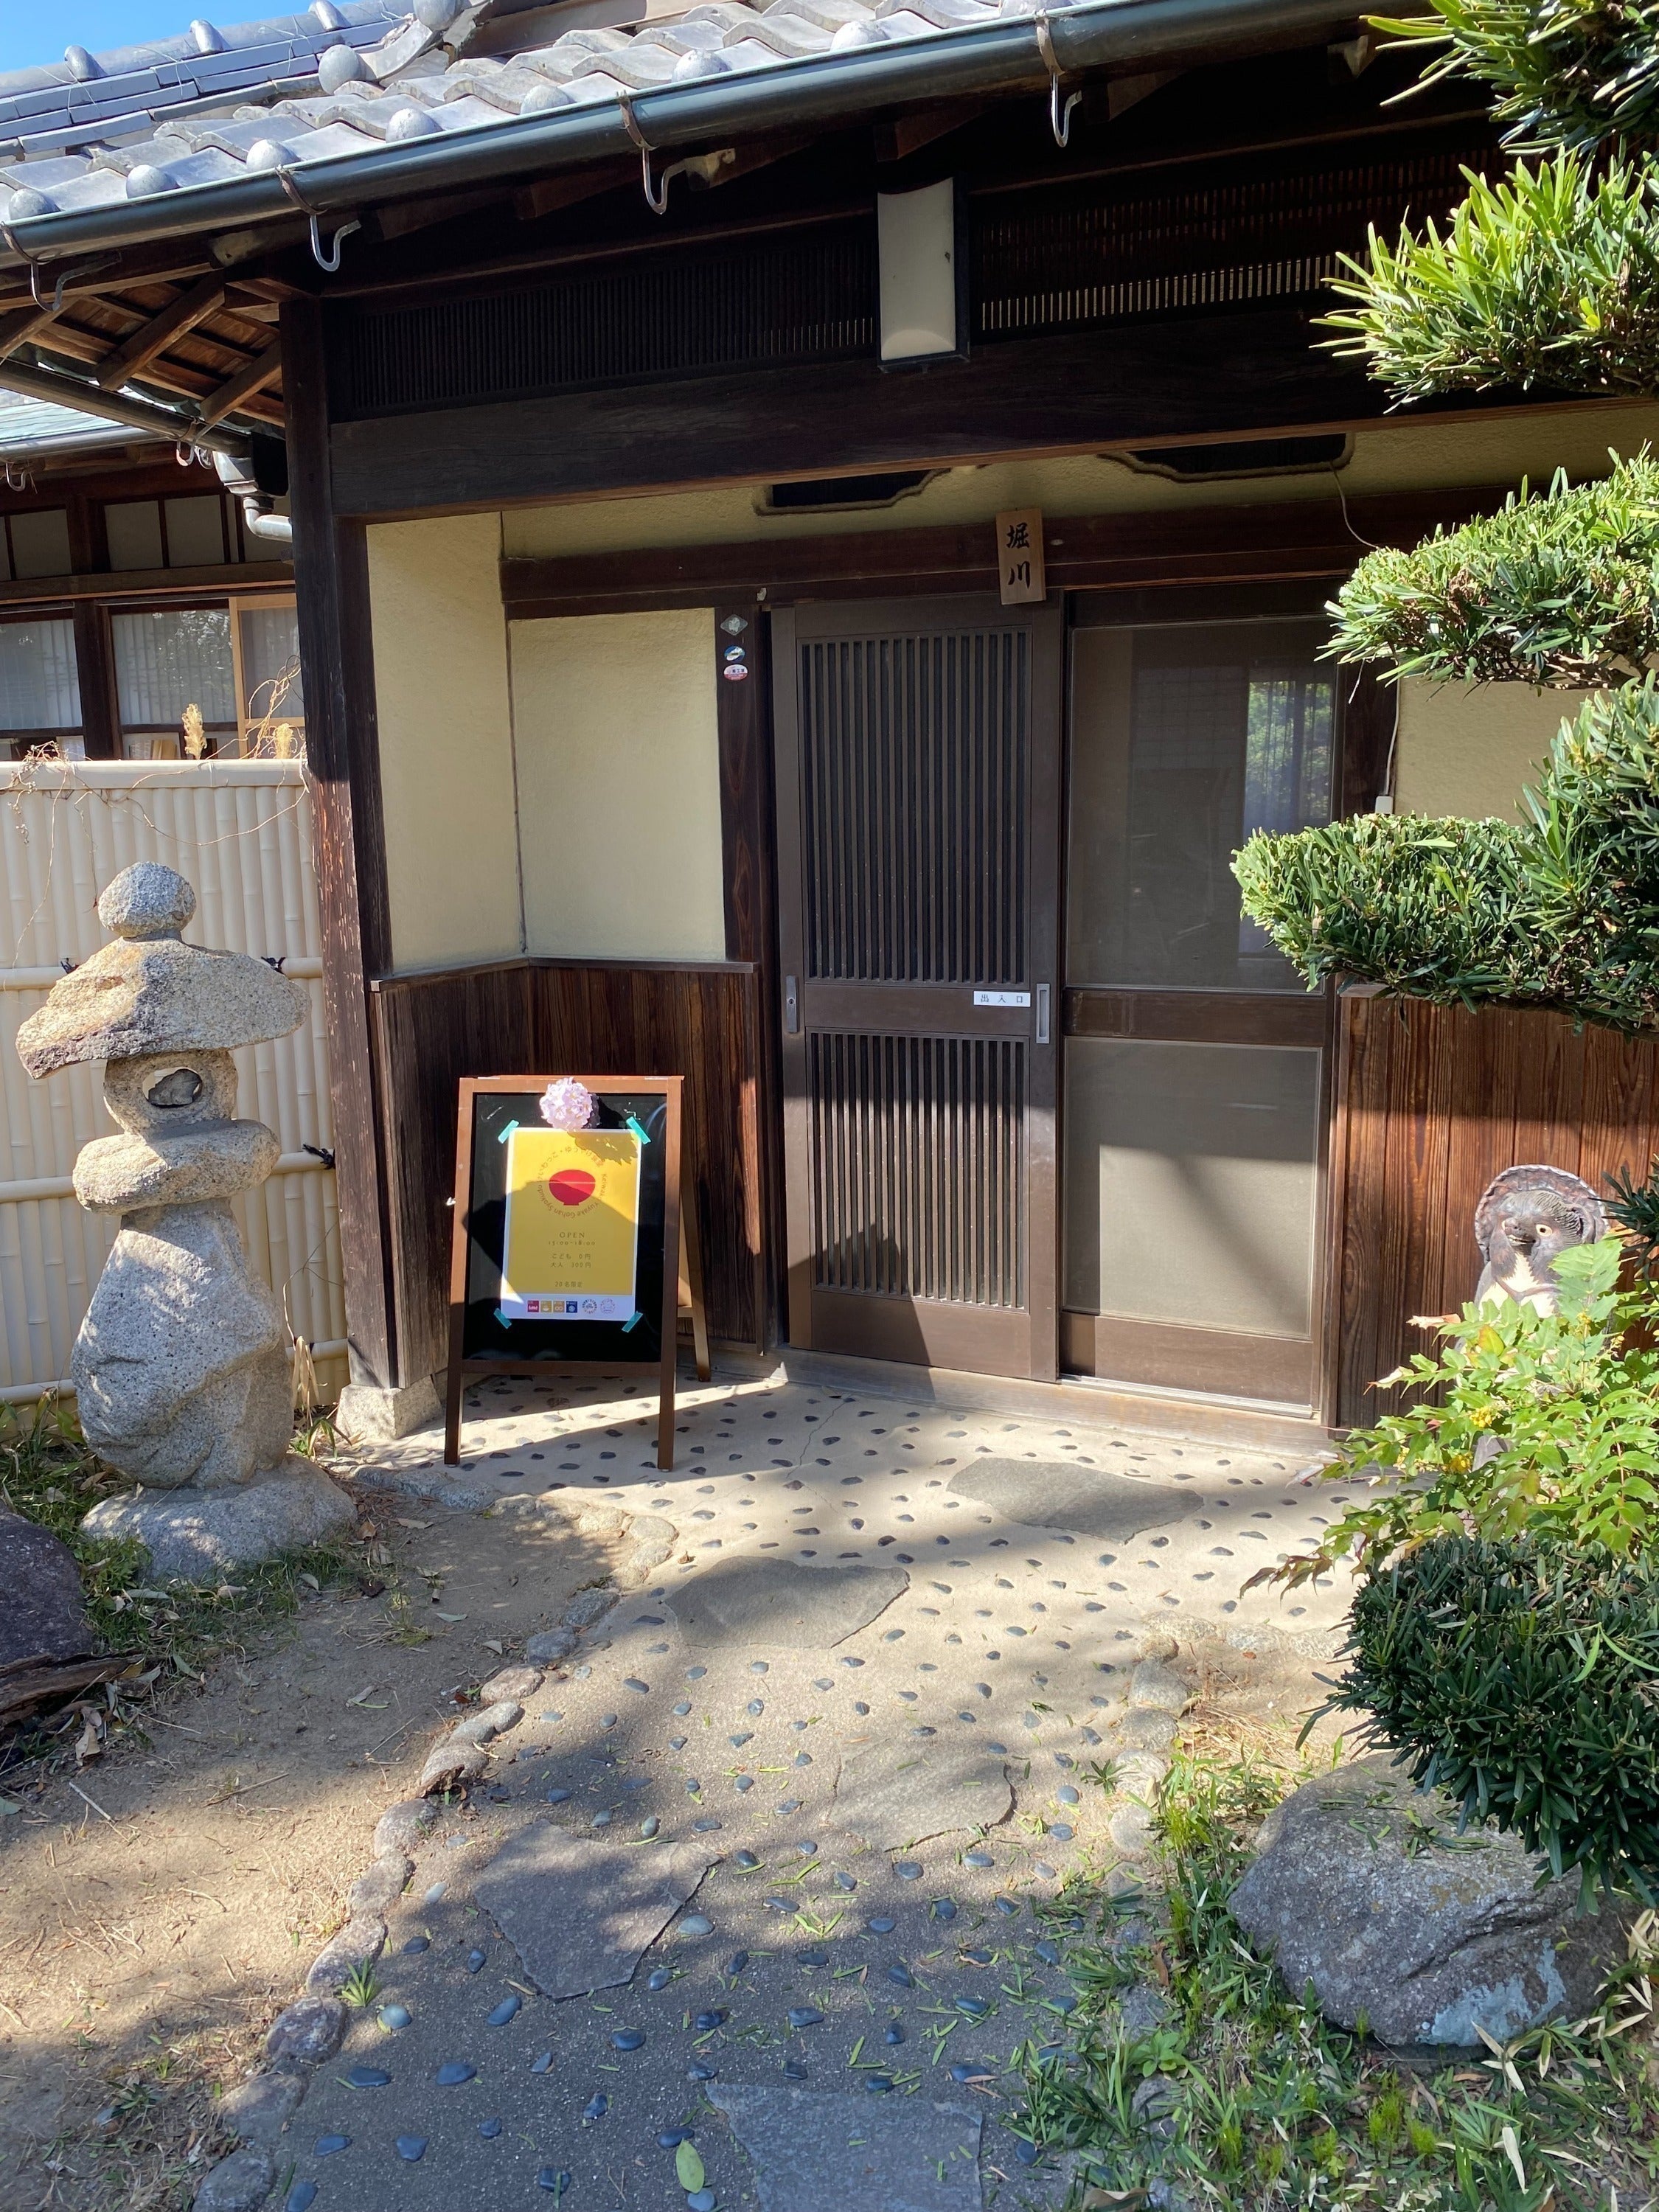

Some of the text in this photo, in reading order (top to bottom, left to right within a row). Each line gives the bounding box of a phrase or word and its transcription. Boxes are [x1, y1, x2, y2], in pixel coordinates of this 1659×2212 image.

[1006, 522, 1031, 589] 堀川
[981, 993, 1023, 1004] 出入口
[537, 1184, 553, 1211] Syokudo
[554, 1208, 575, 1219] Gohan
[577, 1202, 601, 1217] Yuyake
